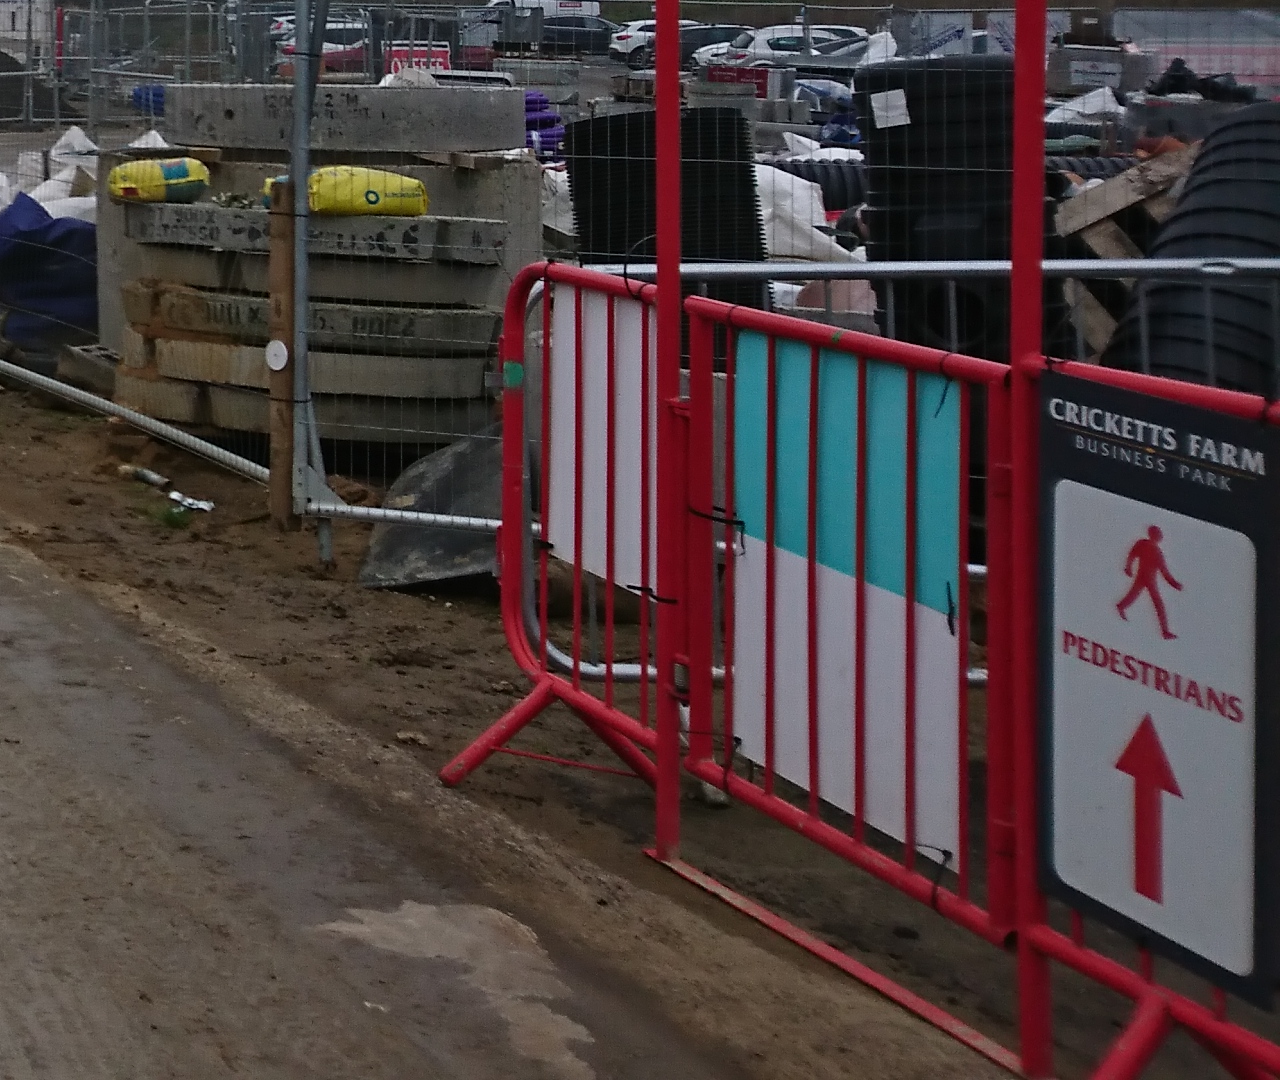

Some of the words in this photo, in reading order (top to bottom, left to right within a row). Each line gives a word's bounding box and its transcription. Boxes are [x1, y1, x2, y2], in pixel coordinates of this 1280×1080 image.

[1049, 398, 1177, 451] CRICKETTS
[1187, 433, 1266, 476] FARM
[1075, 434, 1167, 474] BUSINESS
[1178, 465, 1232, 493] PARK
[1062, 630, 1245, 724] PEDESTRIANS
